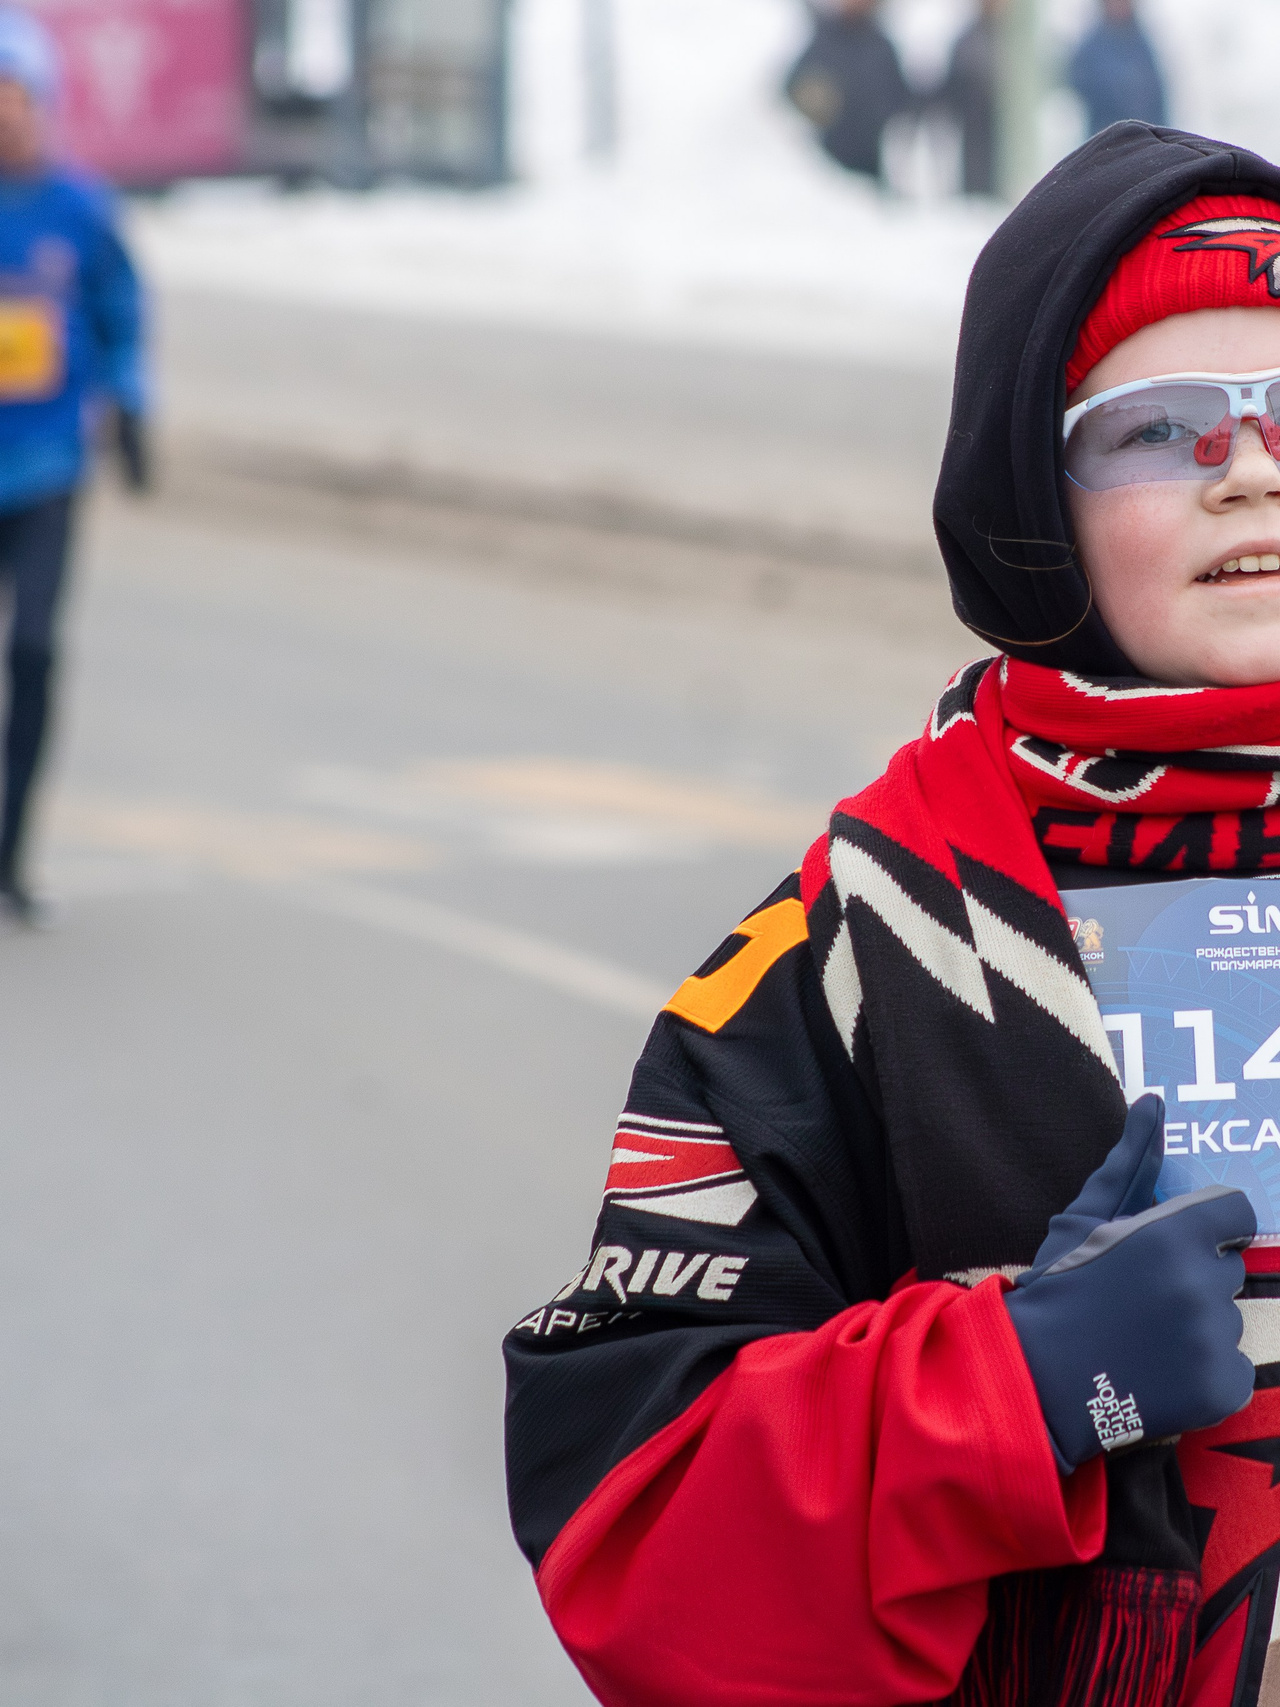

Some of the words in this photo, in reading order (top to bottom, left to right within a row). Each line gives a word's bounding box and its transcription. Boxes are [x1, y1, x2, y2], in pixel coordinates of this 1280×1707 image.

[551, 1243, 749, 1305] RIVE
[514, 1307, 643, 1336] АРЕ
[1086, 1396, 1115, 1441] FACE
[1092, 1371, 1127, 1437] NORTH
[1120, 1393, 1142, 1431] THE
